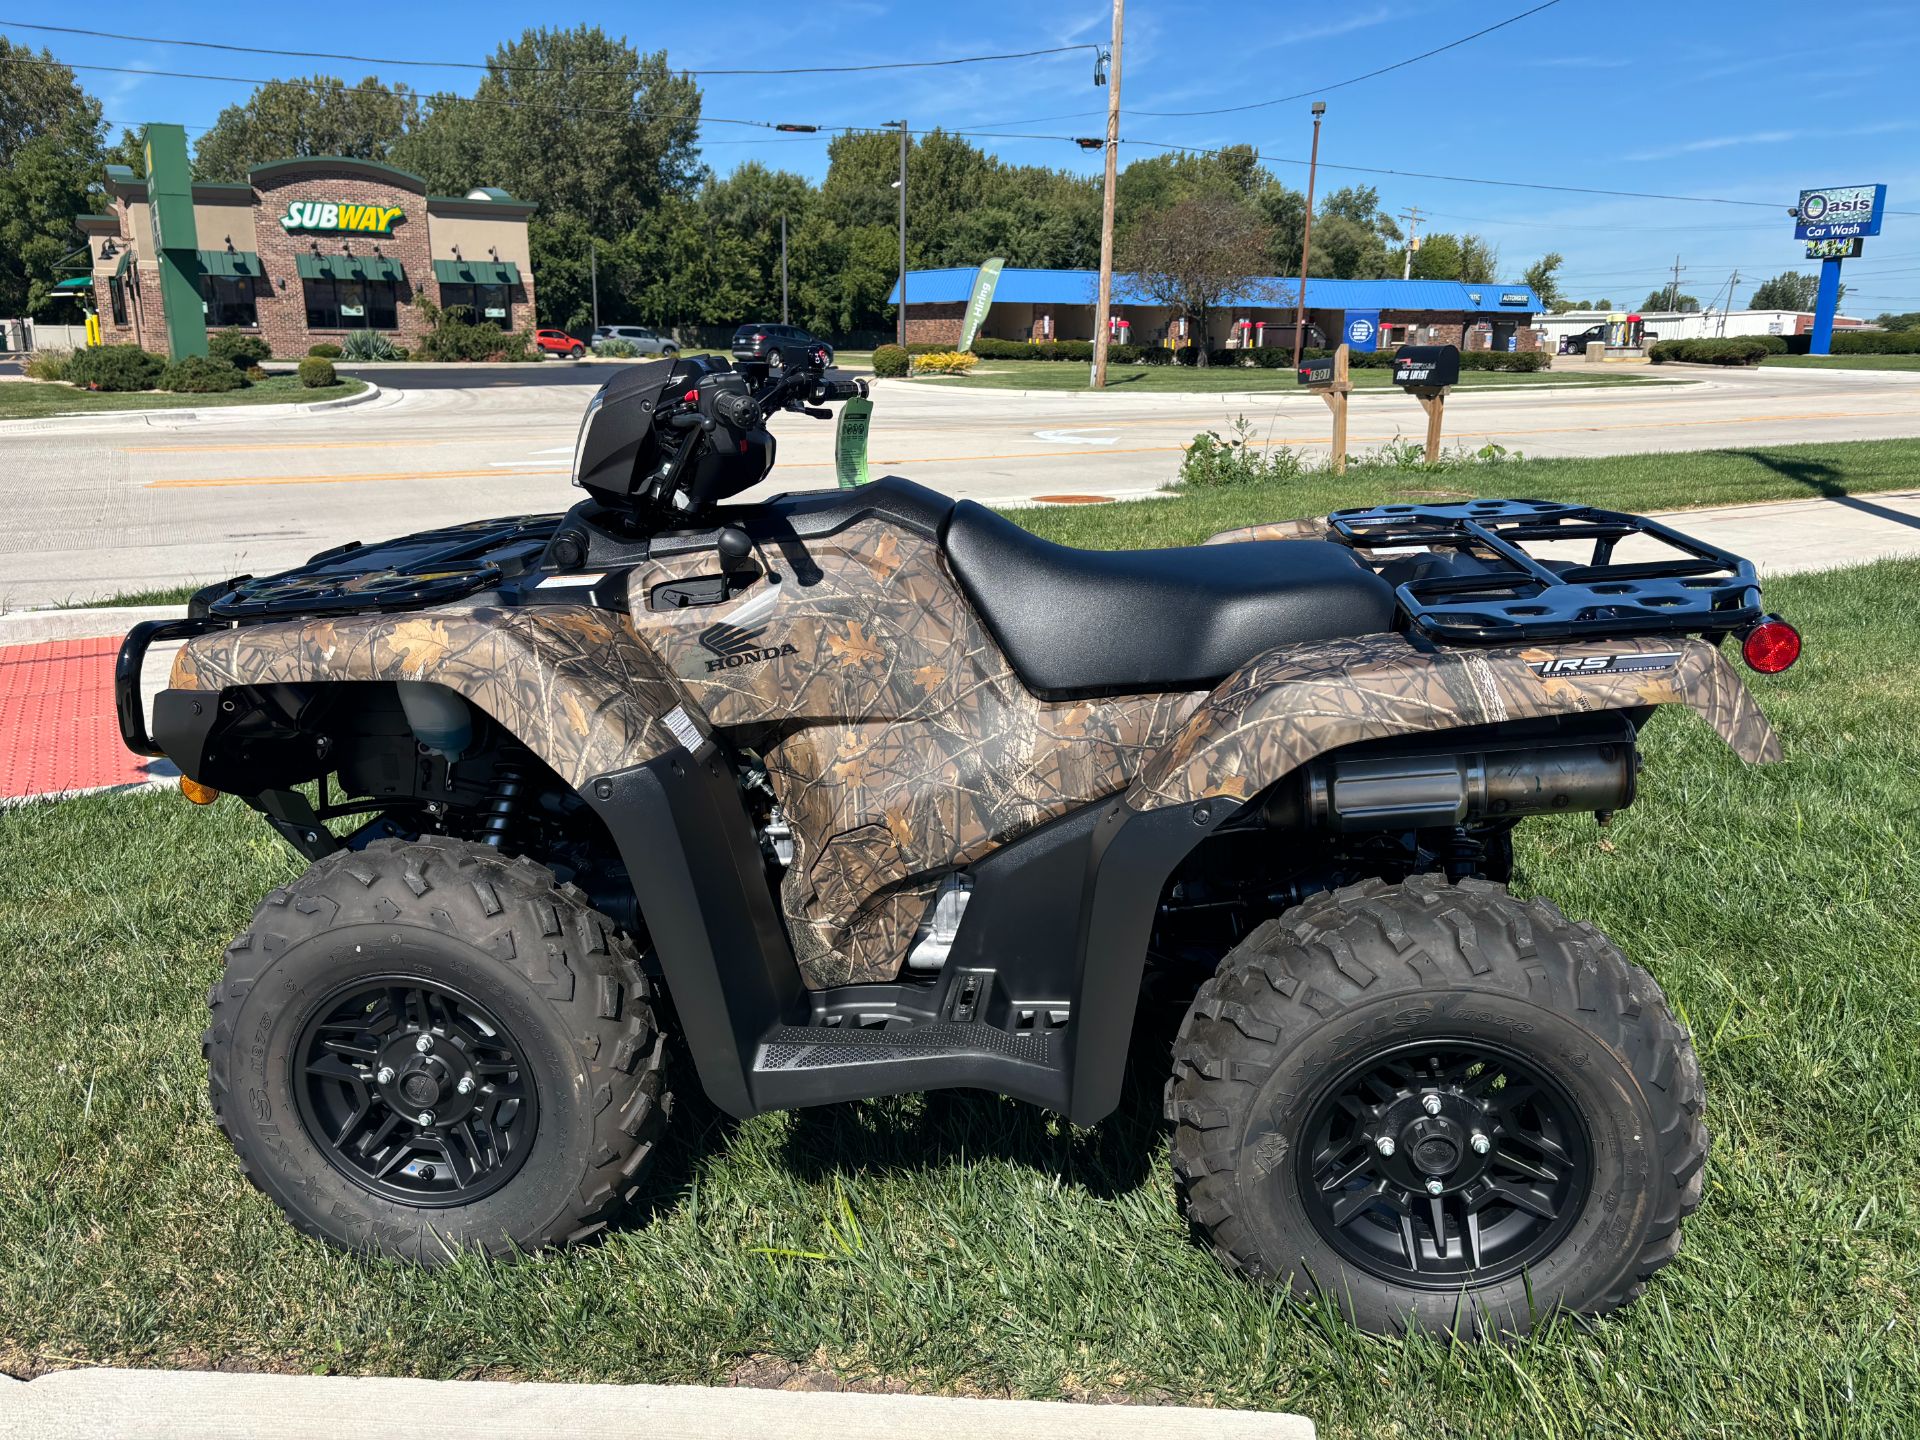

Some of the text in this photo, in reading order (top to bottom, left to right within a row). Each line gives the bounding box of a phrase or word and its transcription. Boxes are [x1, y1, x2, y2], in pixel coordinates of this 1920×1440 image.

[280, 201, 402, 232] SUBWAY
[1803, 192, 1870, 219] Oasis
[1806, 223, 1860, 236] Car Wash
[973, 282, 991, 317] Hiring
[1310, 369, 1329, 381] 1901
[705, 643, 800, 673] HONDA
[1543, 656, 1611, 673] IRS
